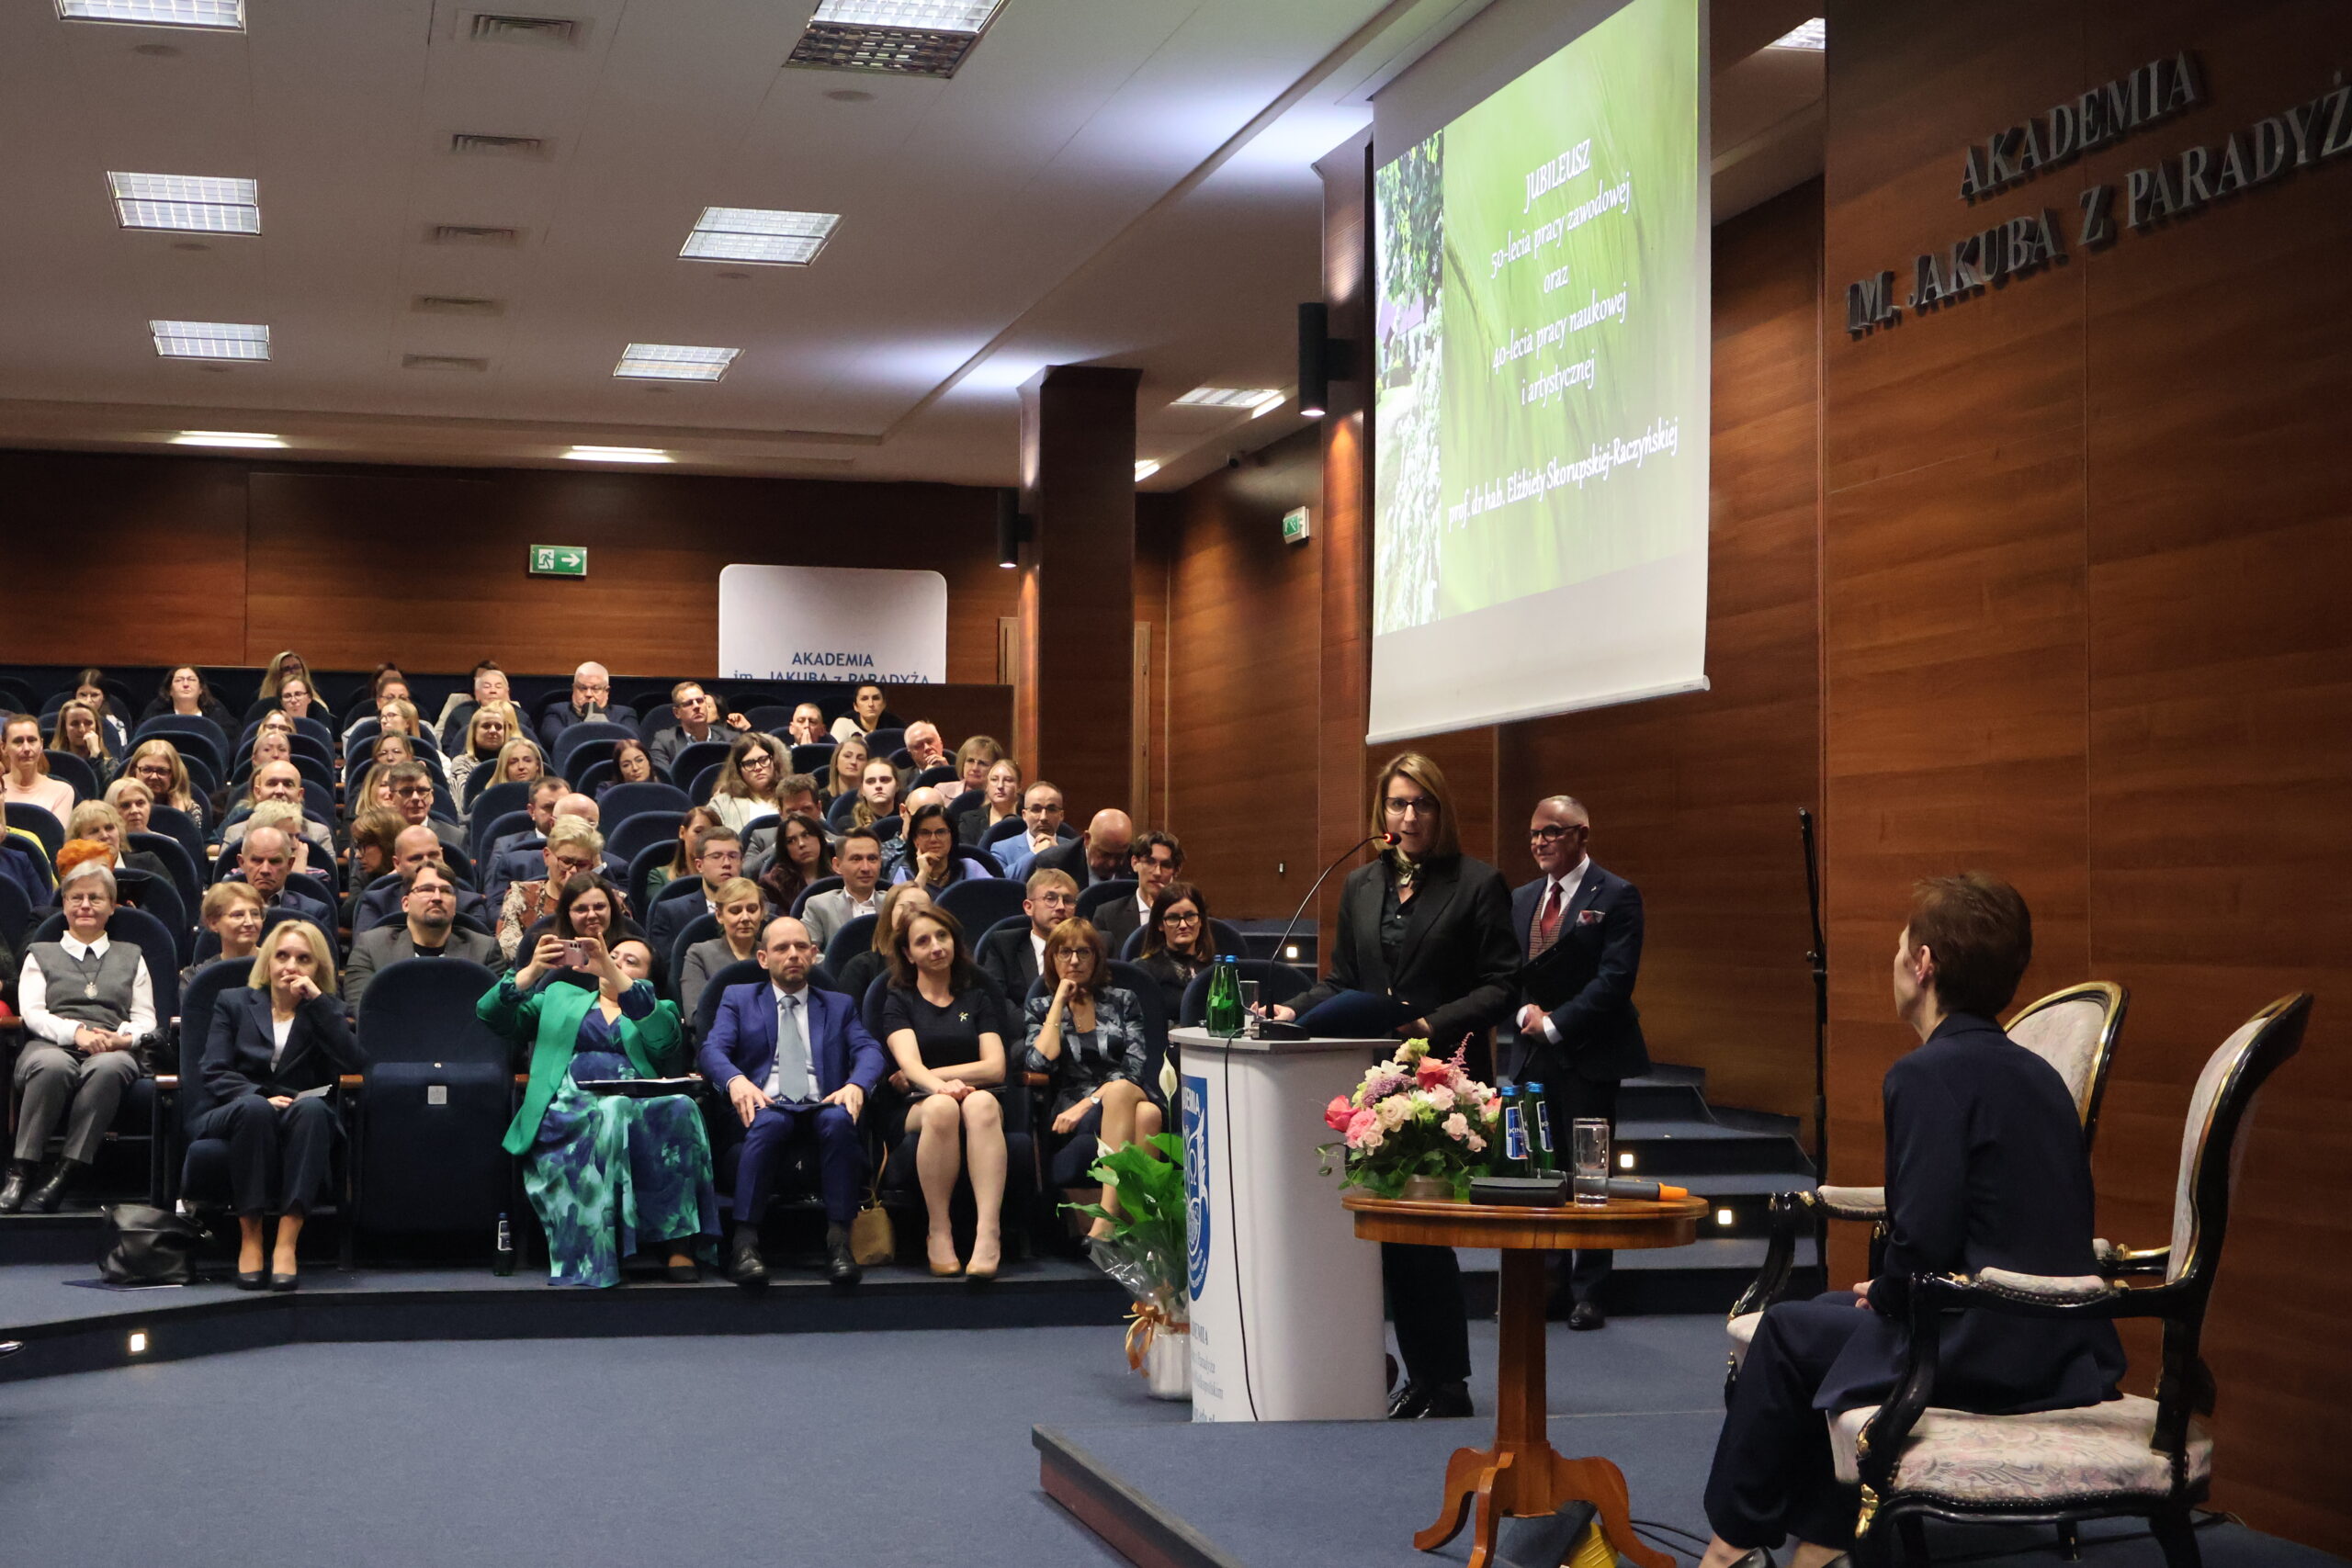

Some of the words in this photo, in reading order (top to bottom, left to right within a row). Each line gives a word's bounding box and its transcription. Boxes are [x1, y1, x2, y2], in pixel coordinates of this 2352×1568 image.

[1959, 50, 2197, 199] AKADEMIA
[1523, 138, 1590, 214] JUBILEUSZ
[1491, 229, 1532, 279] 50-lecia
[1533, 215, 1565, 260] pracy
[1566, 171, 1630, 231] zawodowej
[1906, 207, 2063, 308] JAKUBA
[2077, 186, 2109, 246] Z
[1544, 265, 1568, 294] oraz
[1493, 327, 1533, 375] 40-lecia
[1536, 317, 1566, 360] pracy
[1569, 281, 1627, 333] naukowej
[1521, 378, 1526, 406] i
[1528, 349, 1595, 408] artystycznej
[1448, 488, 1471, 534] prof.
[1471, 484, 1484, 516] dr
[1485, 477, 1506, 512] hab.
[1507, 468, 1546, 503] Elżbiety
[1546, 416, 1679, 490] Skorupskiej-Raczyńskiej
[792, 652, 874, 667] AKADEMIA
